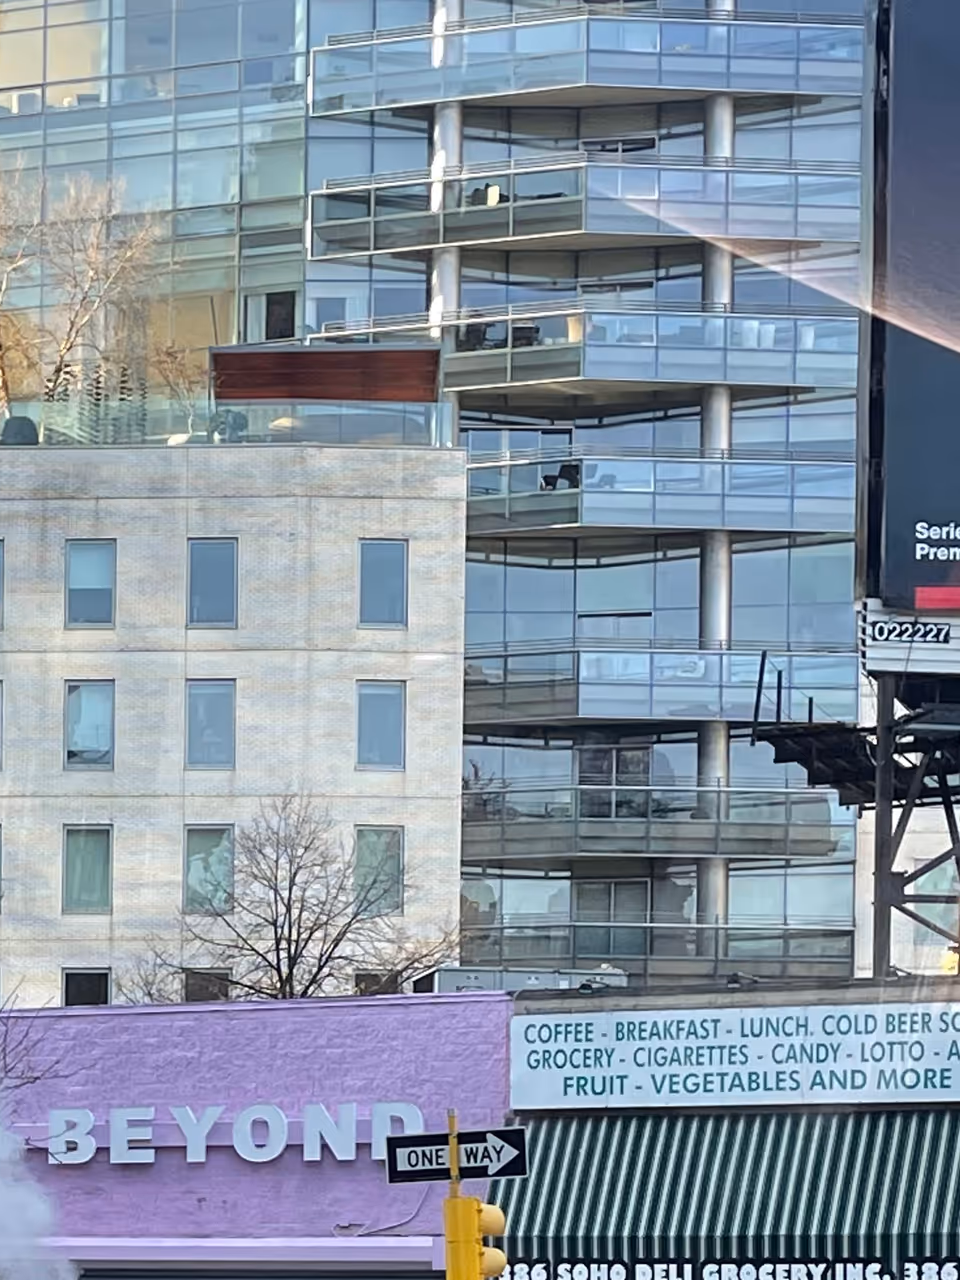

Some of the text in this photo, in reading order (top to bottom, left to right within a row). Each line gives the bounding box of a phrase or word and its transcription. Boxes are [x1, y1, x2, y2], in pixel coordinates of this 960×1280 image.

[524, 1022, 594, 1044] COFFEE
[615, 1019, 721, 1042] BREAKFAST
[821, 1014, 878, 1036] COLD
[885, 1012, 932, 1034] BEER
[527, 1048, 615, 1070] GROCERY
[633, 1044, 749, 1068] CIGARETTES
[771, 1042, 841, 1064] CANDY
[860, 1040, 925, 1063] LOTTO
[563, 1068, 952, 1096] FRUIT VEGETABLES AND MORE
[407, 1144, 505, 1168] ONE WAY
